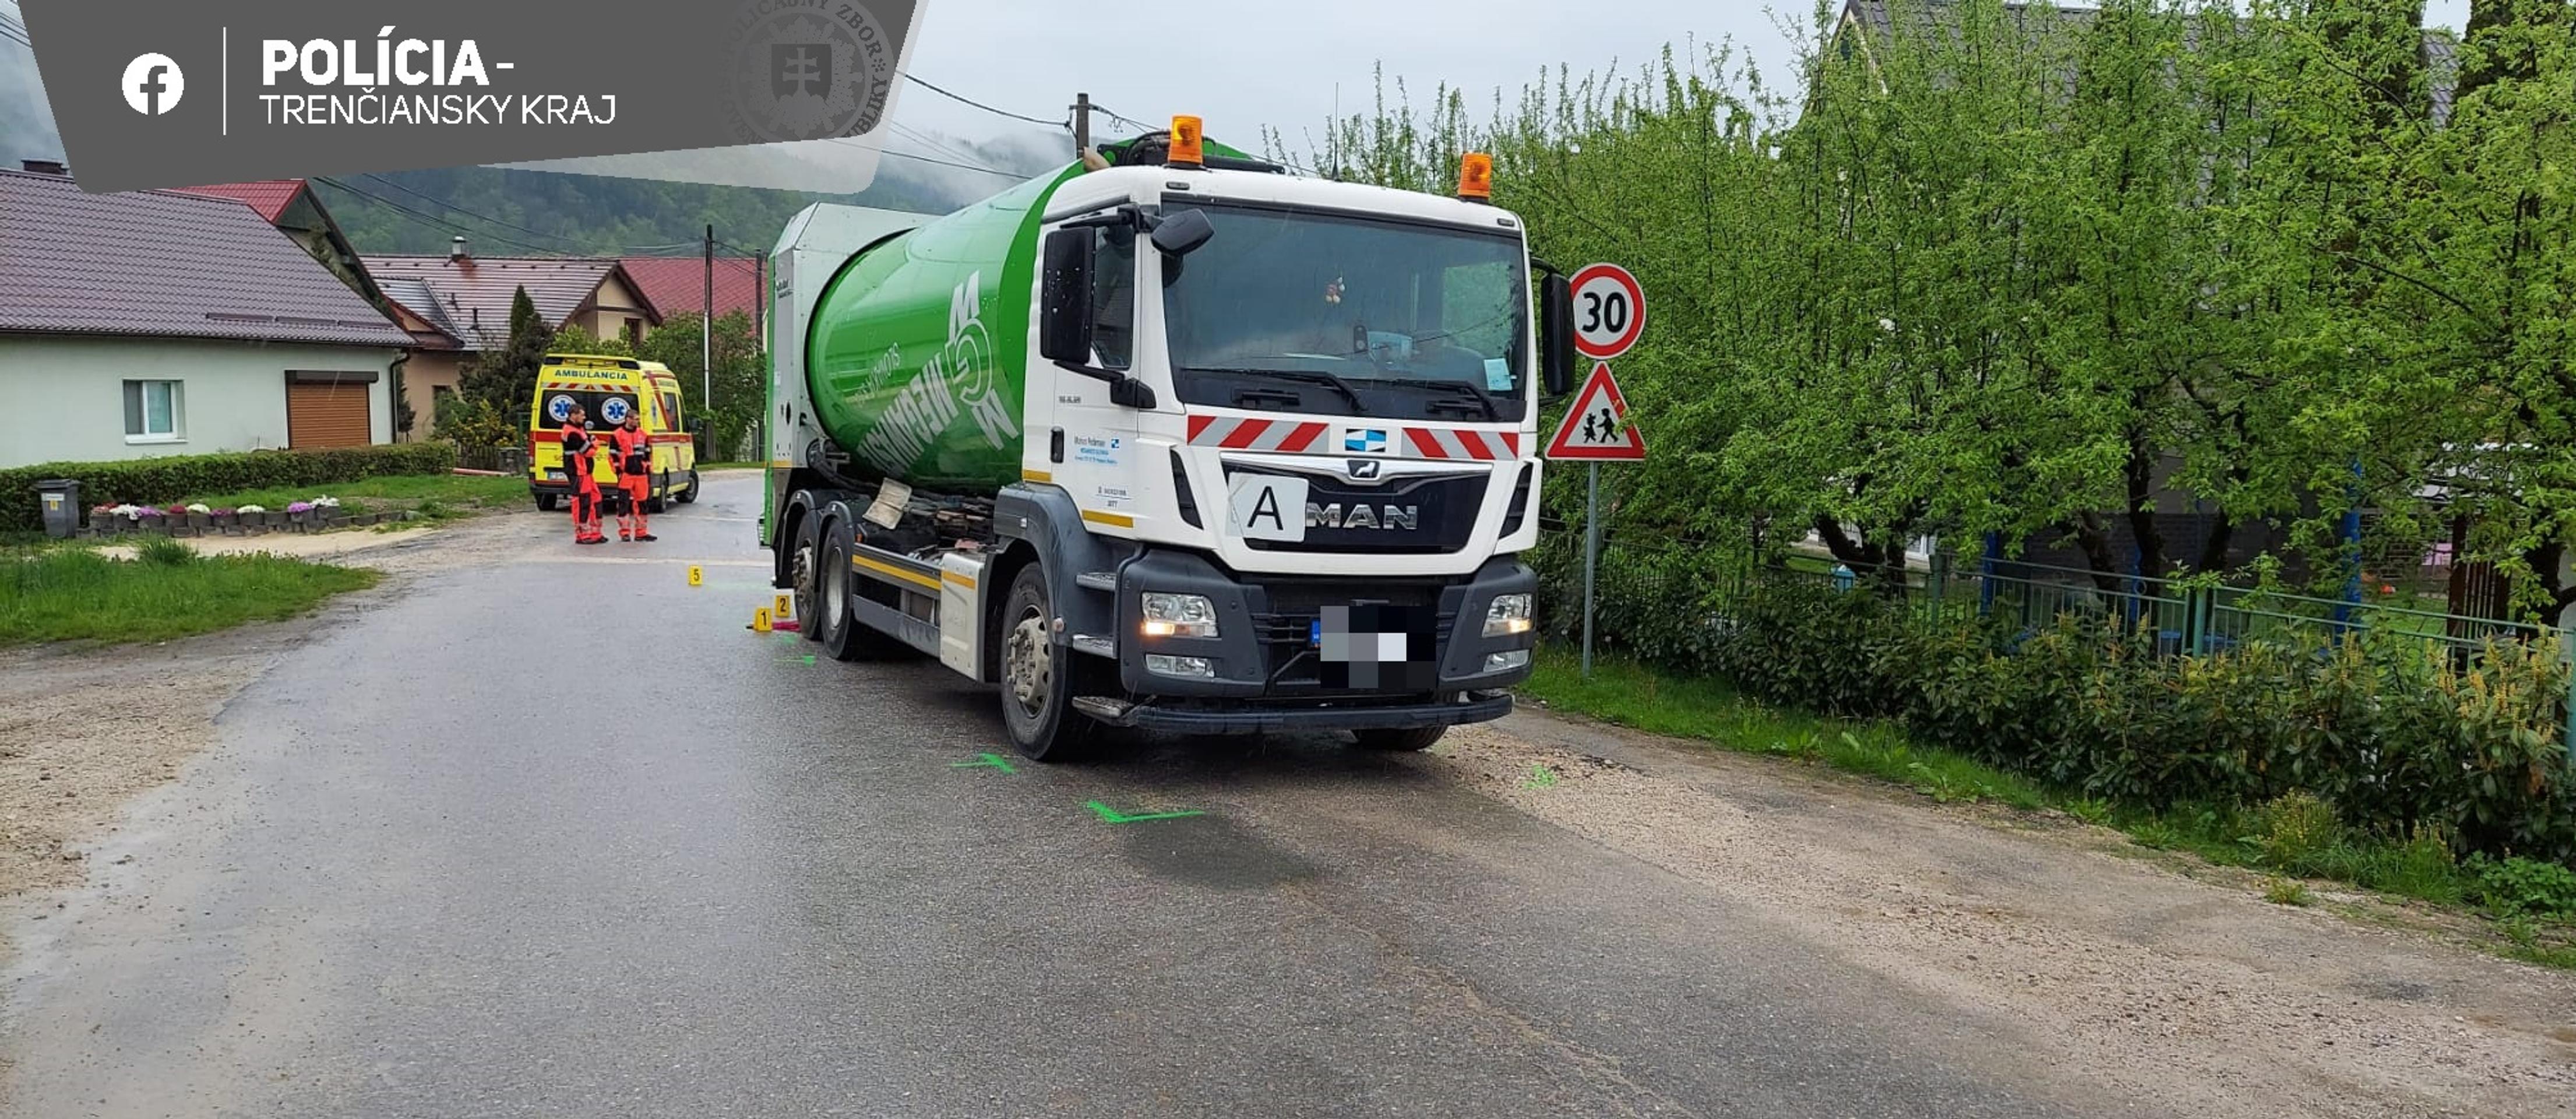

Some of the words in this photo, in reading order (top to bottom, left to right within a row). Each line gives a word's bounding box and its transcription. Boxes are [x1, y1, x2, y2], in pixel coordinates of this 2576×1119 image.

[1582, 292, 1627, 333] 30
[554, 368, 628, 381] AMBULANCIA
[1248, 486, 1284, 530] A
[1305, 502, 1417, 530] MAN
[693, 568, 700, 582] 5
[780, 597, 786, 612] 2
[761, 611, 767, 626] 1
